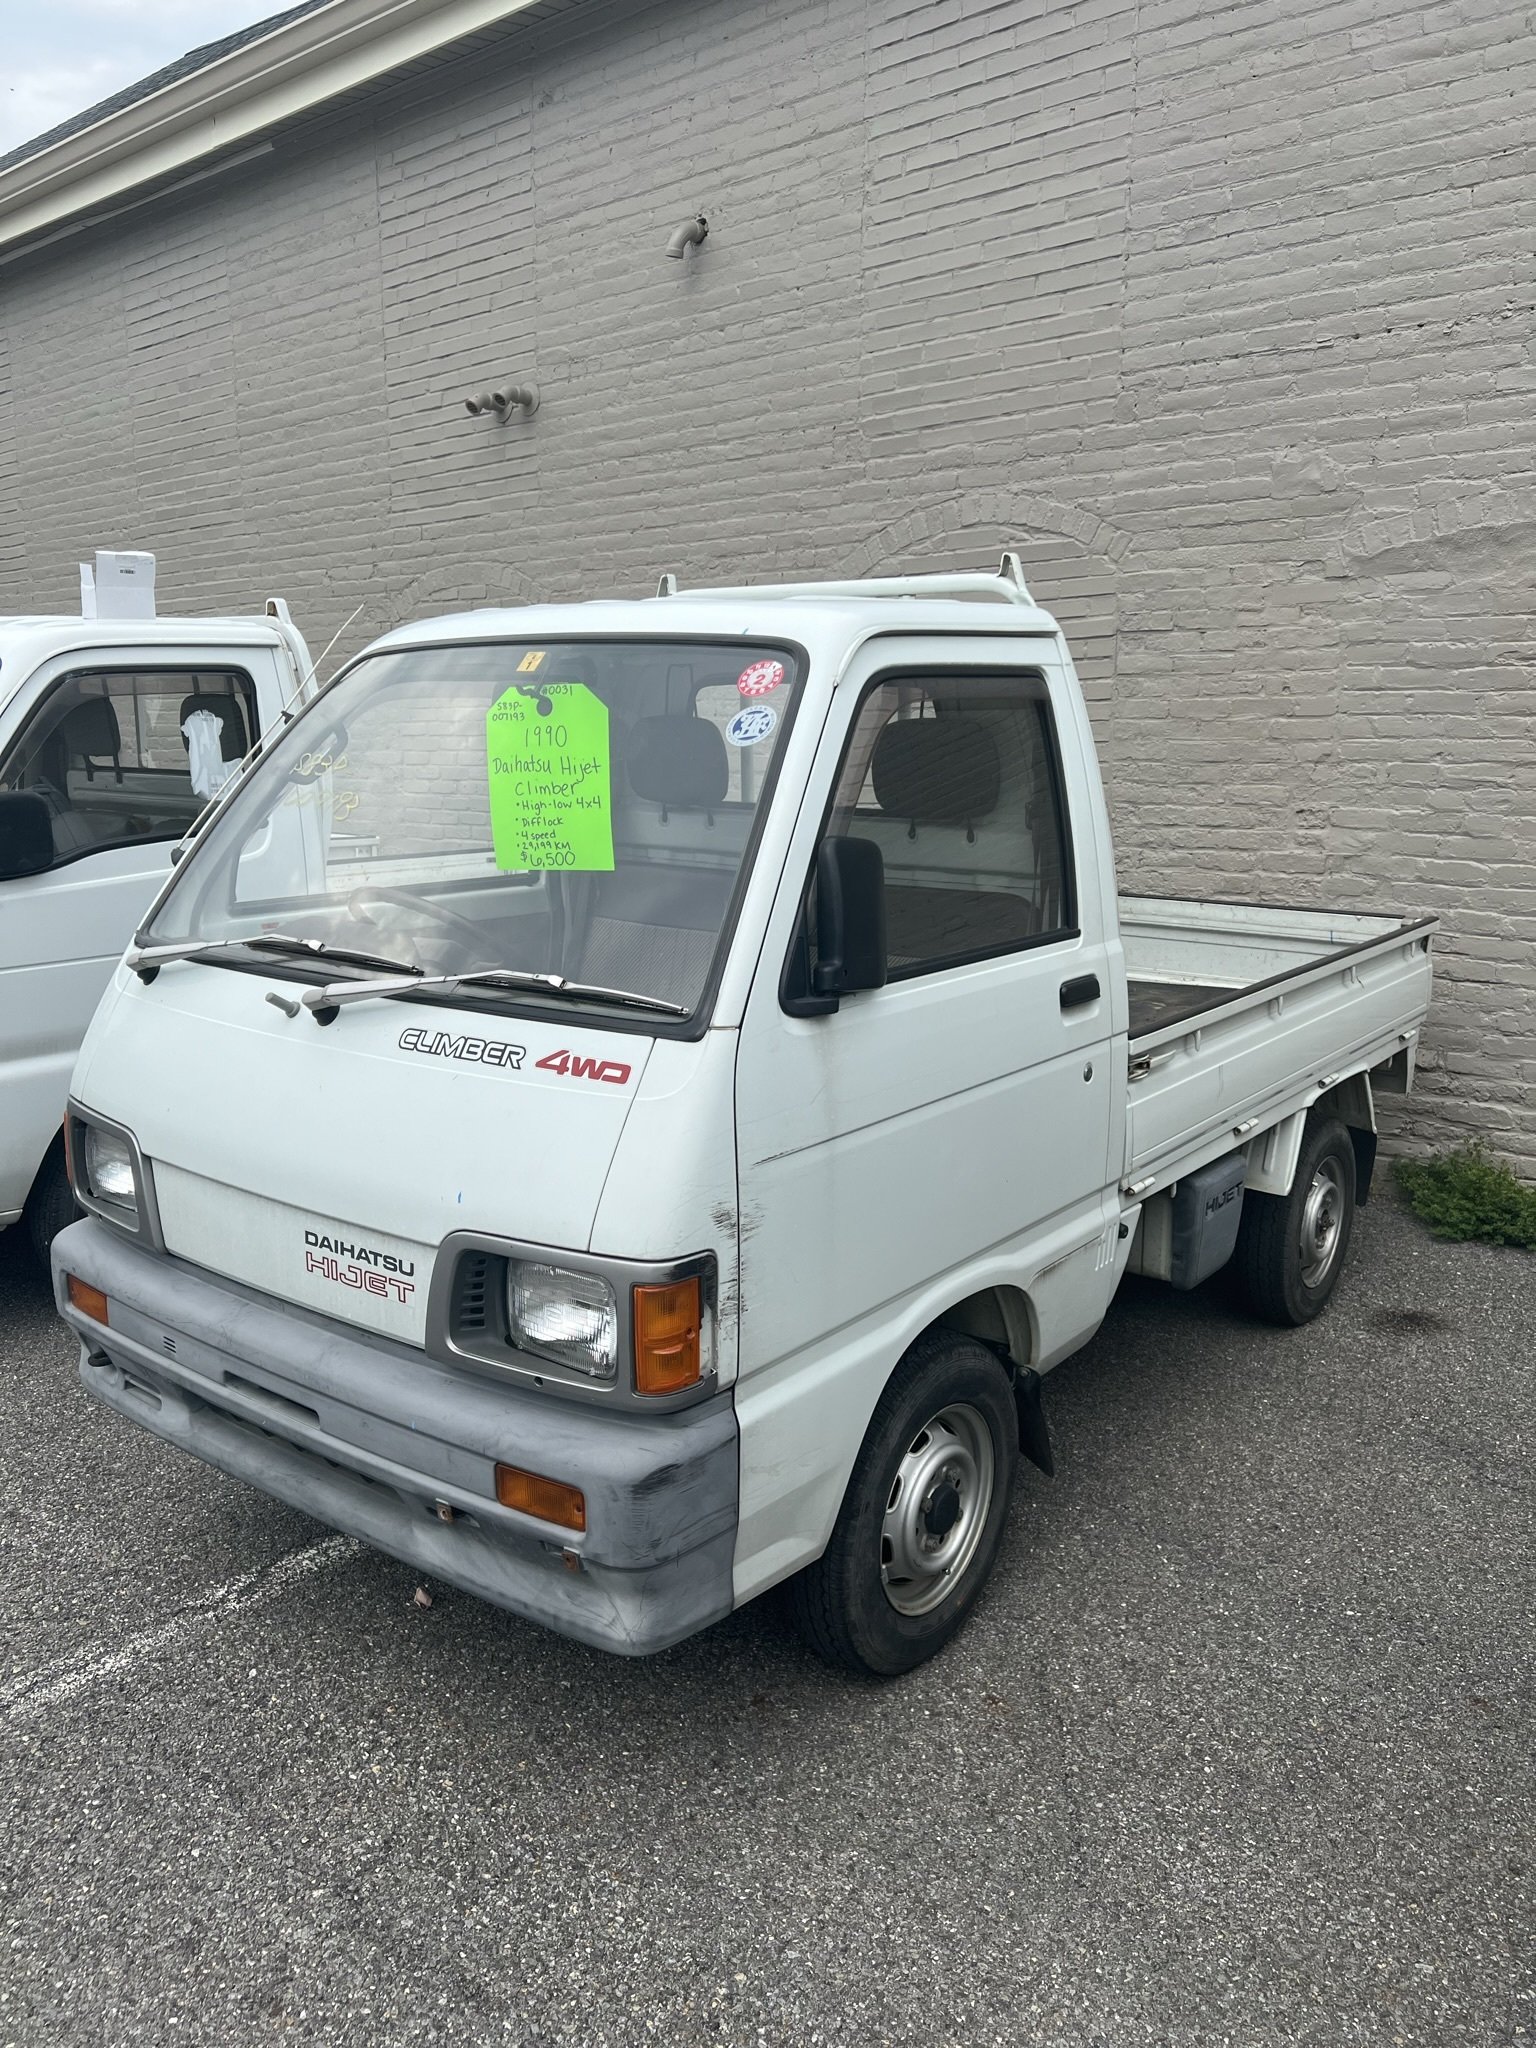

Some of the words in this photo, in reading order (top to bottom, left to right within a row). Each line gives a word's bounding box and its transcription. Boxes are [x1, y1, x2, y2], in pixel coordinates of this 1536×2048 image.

[753, 674, 766, 685] 2
[525, 725, 567, 748] 1990
[493, 754, 552, 775] Daihatsu
[560, 755, 602, 783] Hijet
[515, 780, 578, 798] Climber
[522, 799, 573, 815] High-low
[576, 795, 602, 809] 4x4
[521, 831, 529, 840] 4
[531, 829, 556, 841] speed
[522, 841, 552, 852] 29,199
[399, 1028, 527, 1070] CLIMBER
[535, 1049, 632, 1085] 4WD
[1205, 1180, 1244, 1217] HIJET
[304, 1230, 415, 1277] DAIHATSU
[305, 1250, 415, 1304] HIJET
